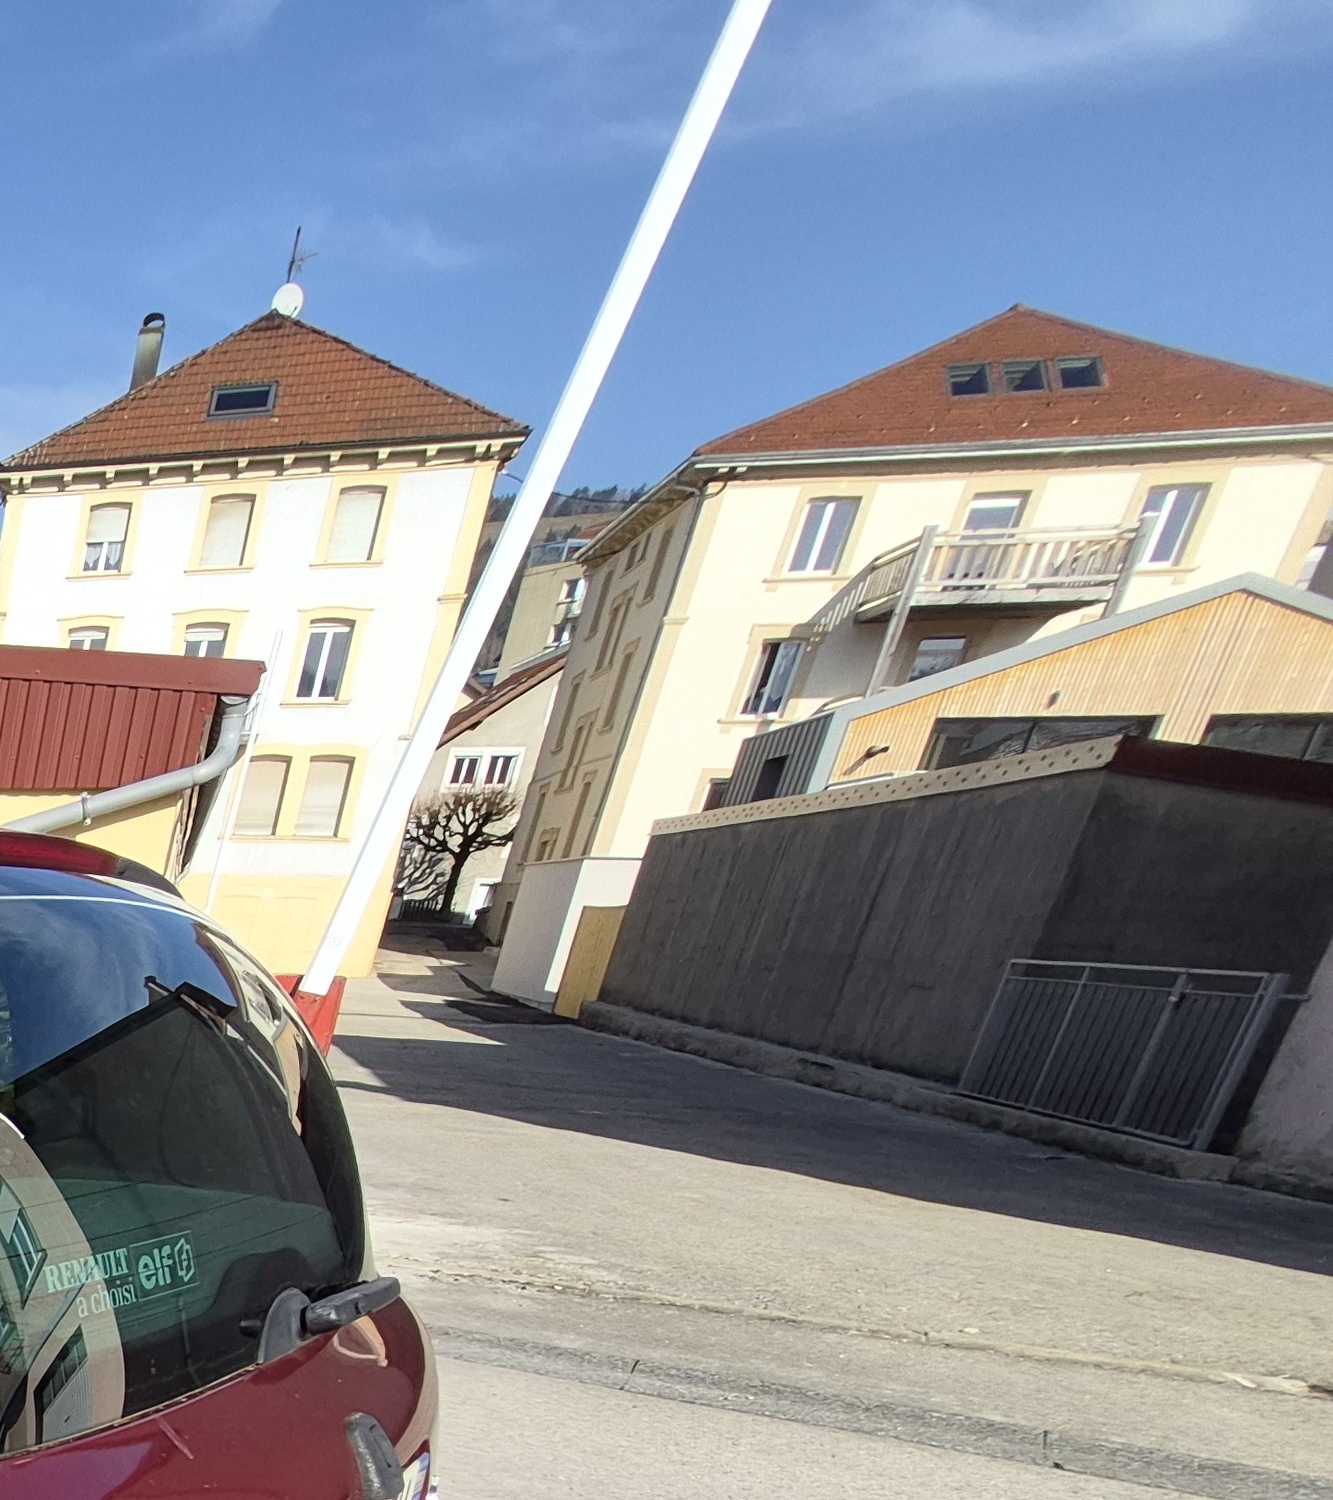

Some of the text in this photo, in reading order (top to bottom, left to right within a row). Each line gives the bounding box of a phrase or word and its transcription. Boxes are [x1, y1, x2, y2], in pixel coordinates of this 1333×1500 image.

[44, 1244, 174, 1293] RENAULT elf
[77, 1276, 139, 1318] a choisi
